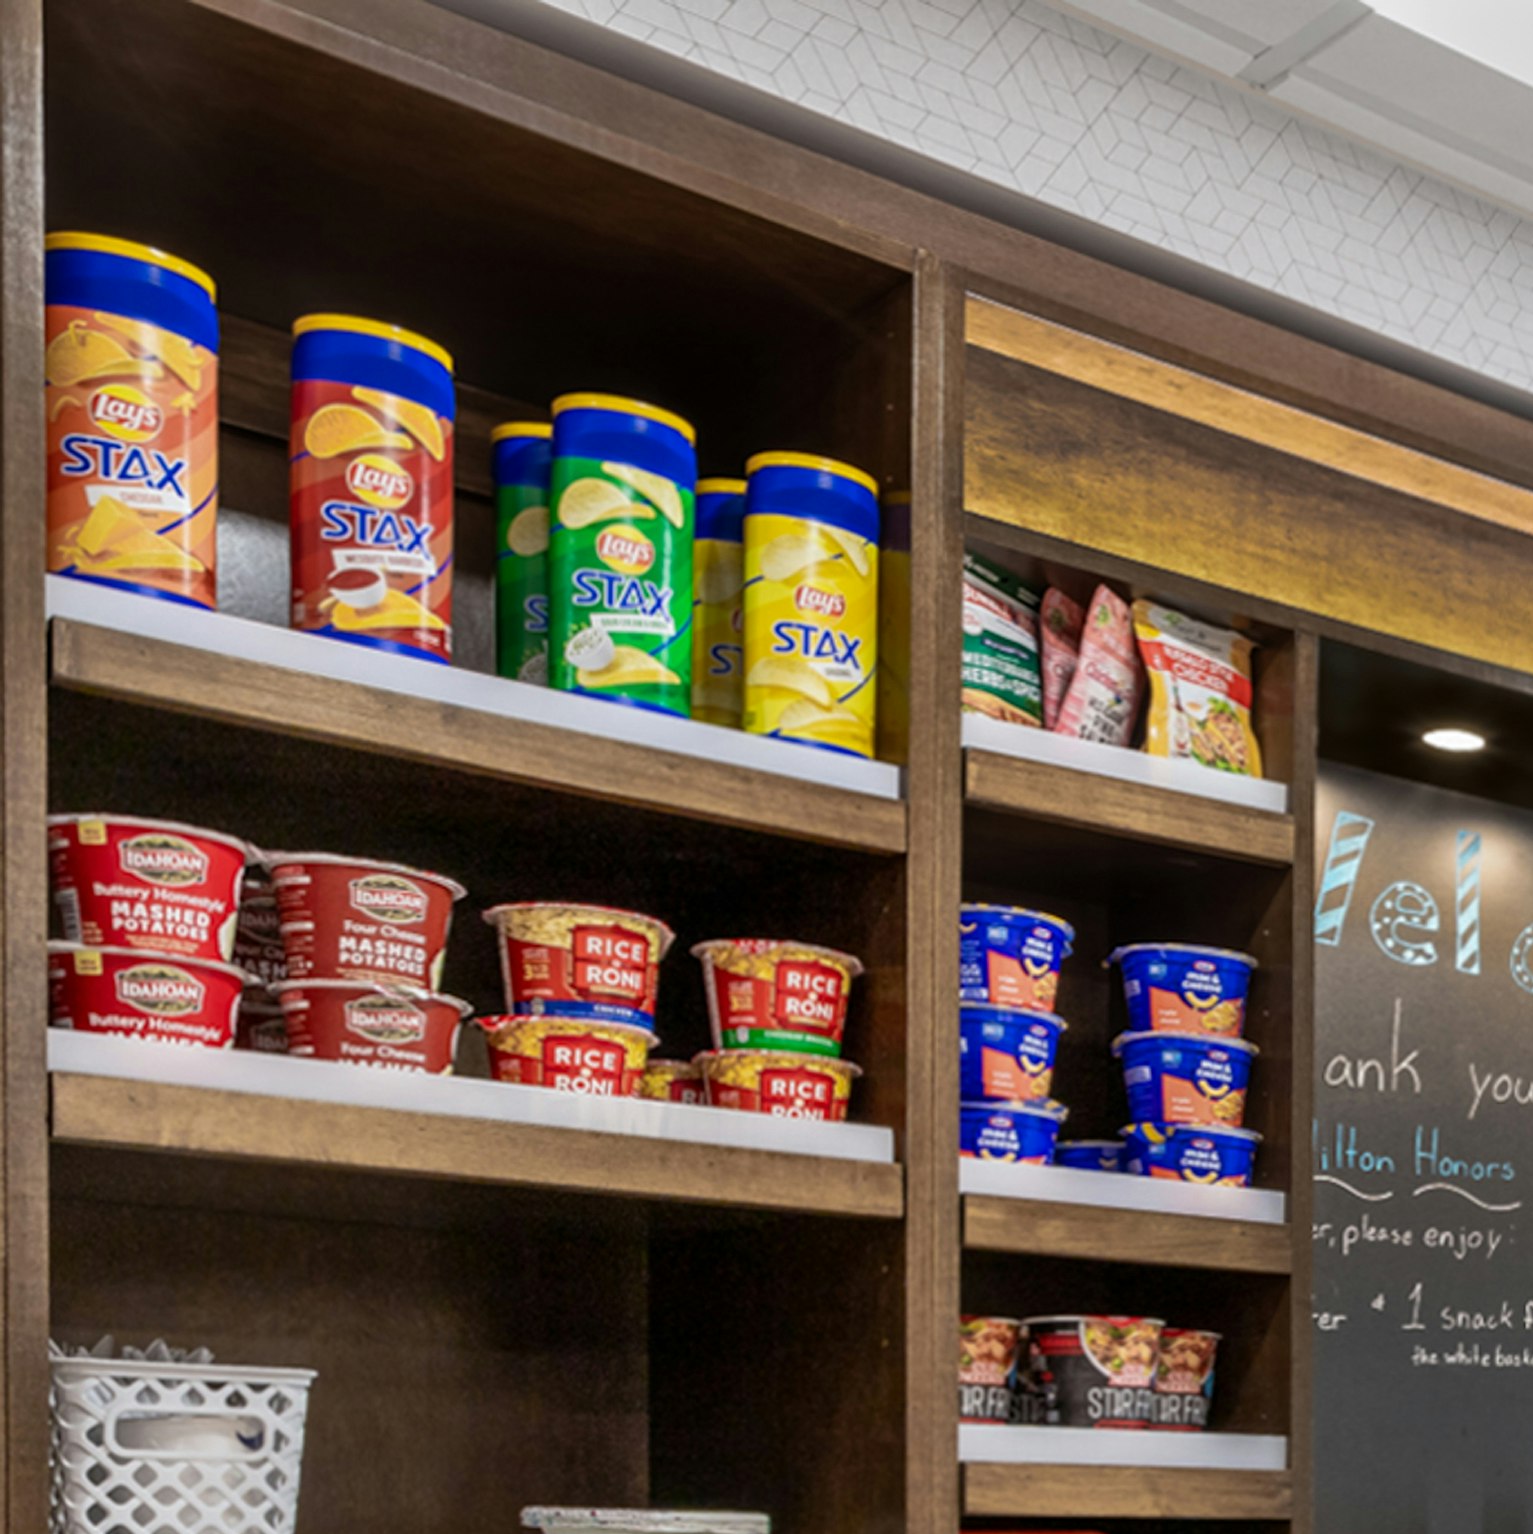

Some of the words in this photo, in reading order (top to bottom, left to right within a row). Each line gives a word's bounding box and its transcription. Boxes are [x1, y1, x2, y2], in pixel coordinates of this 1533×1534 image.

[94, 392, 159, 431] Lay's
[60, 435, 185, 497] STAX
[352, 464, 408, 496] Lay's
[321, 502, 432, 560] STAX
[600, 534, 653, 565] Lay's
[573, 569, 672, 622] STAX
[773, 622, 862, 670] STAX
[124, 848, 205, 874] IDAHOAN
[92, 882, 150, 901] Buttery
[153, 887, 225, 913] Homestyle
[356, 888, 424, 910] IDAHOAN
[111, 901, 210, 928] MASHED
[111, 916, 209, 942] POTATOES
[343, 920, 376, 936] Four
[380, 923, 427, 945] Cheese
[338, 936, 426, 962] MASHED
[586, 936, 643, 961] RICE
[338, 951, 425, 977] POTATOES
[123, 979, 200, 1002] IDAHOAN
[586, 966, 642, 989] RONI
[786, 970, 838, 994] RICE
[786, 998, 833, 1019] RONI
[340, 1042, 375, 1057] Four
[554, 1047, 617, 1070] RICE
[555, 1074, 615, 1096] RONI
[771, 1079, 826, 1101] RICE
[1415, 1124, 1516, 1179] Honors
[1342, 1214, 1413, 1256] please
[1441, 1301, 1514, 1332] snack
[1443, 1345, 1492, 1367] white
